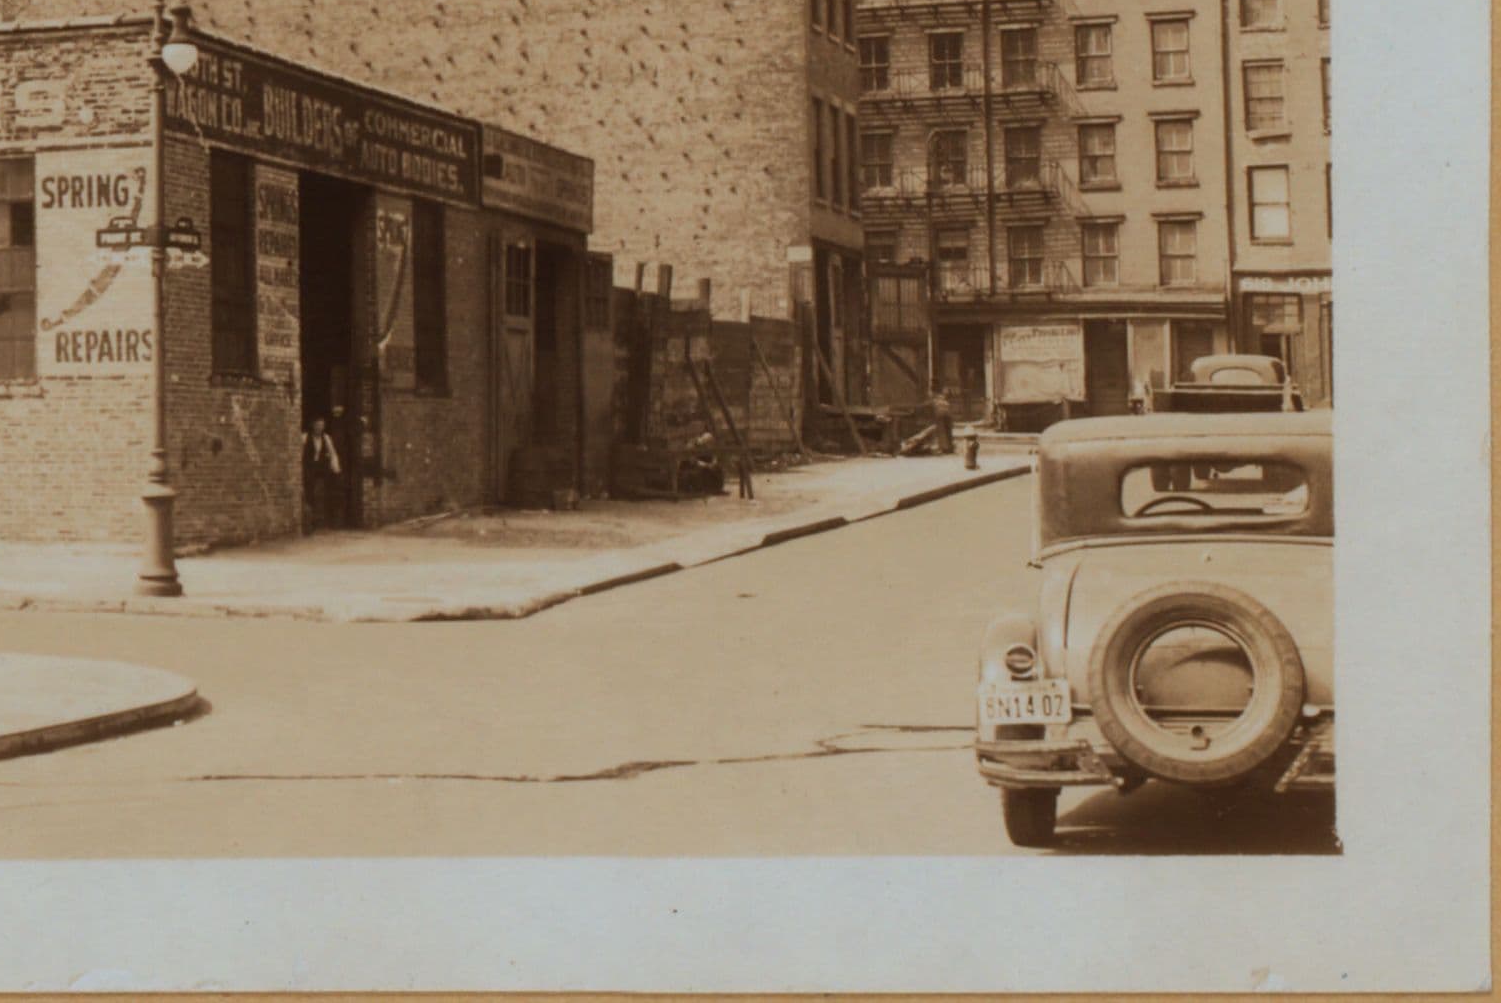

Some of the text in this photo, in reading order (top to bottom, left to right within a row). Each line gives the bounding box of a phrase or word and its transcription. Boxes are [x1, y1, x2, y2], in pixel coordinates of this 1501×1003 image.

[263, 82, 343, 156] BUILDERS
[364, 108, 466, 158] COMMERCIAL
[360, 140, 398, 176] AUTO
[40, 174, 130, 209] SPRING
[55, 329, 153, 364] REPAIRS
